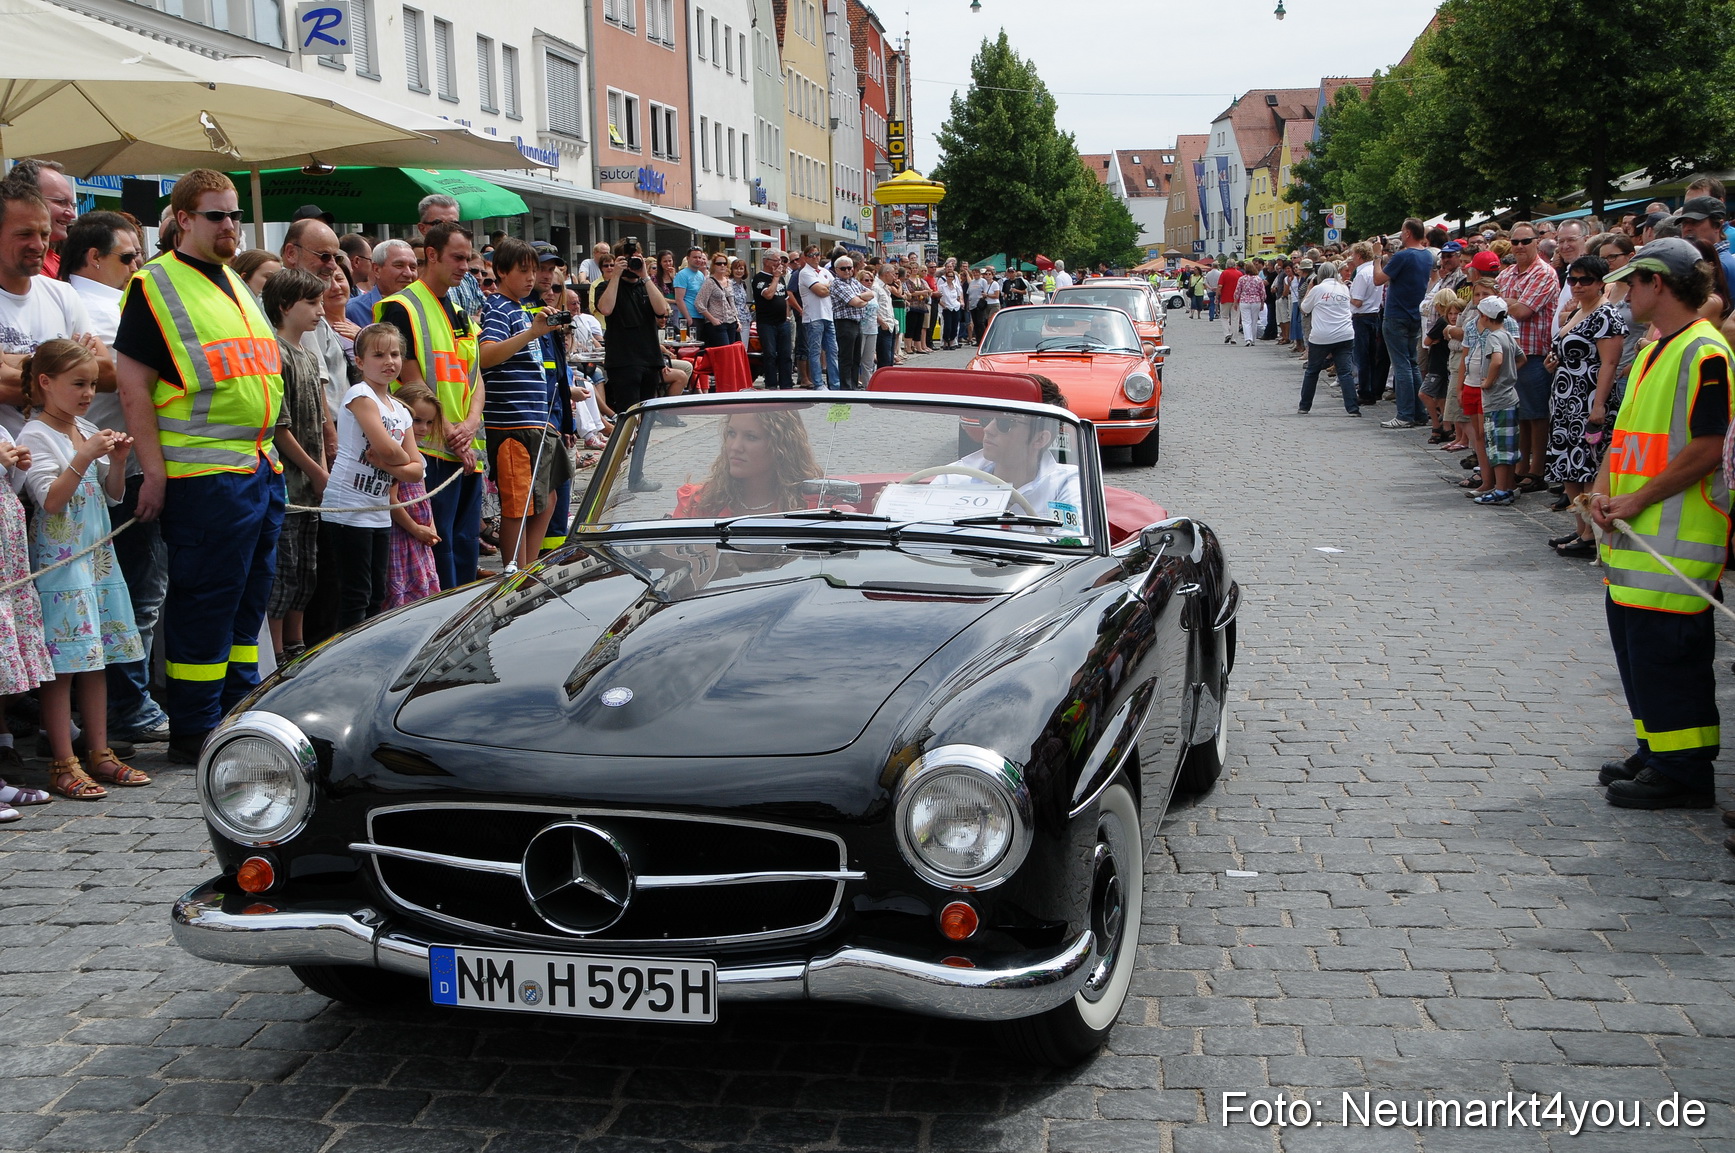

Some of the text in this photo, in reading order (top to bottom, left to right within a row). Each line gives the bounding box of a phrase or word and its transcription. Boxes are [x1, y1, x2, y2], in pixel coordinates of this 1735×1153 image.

[302, 8, 346, 47] R.
[600, 168, 636, 180] sutor.
[954, 495, 989, 509] 50
[1053, 509, 1078, 527] 3 98
[440, 981, 449, 994] D
[456, 954, 515, 1003] NM
[547, 961, 576, 1008] H
[587, 963, 711, 1015] 595H
